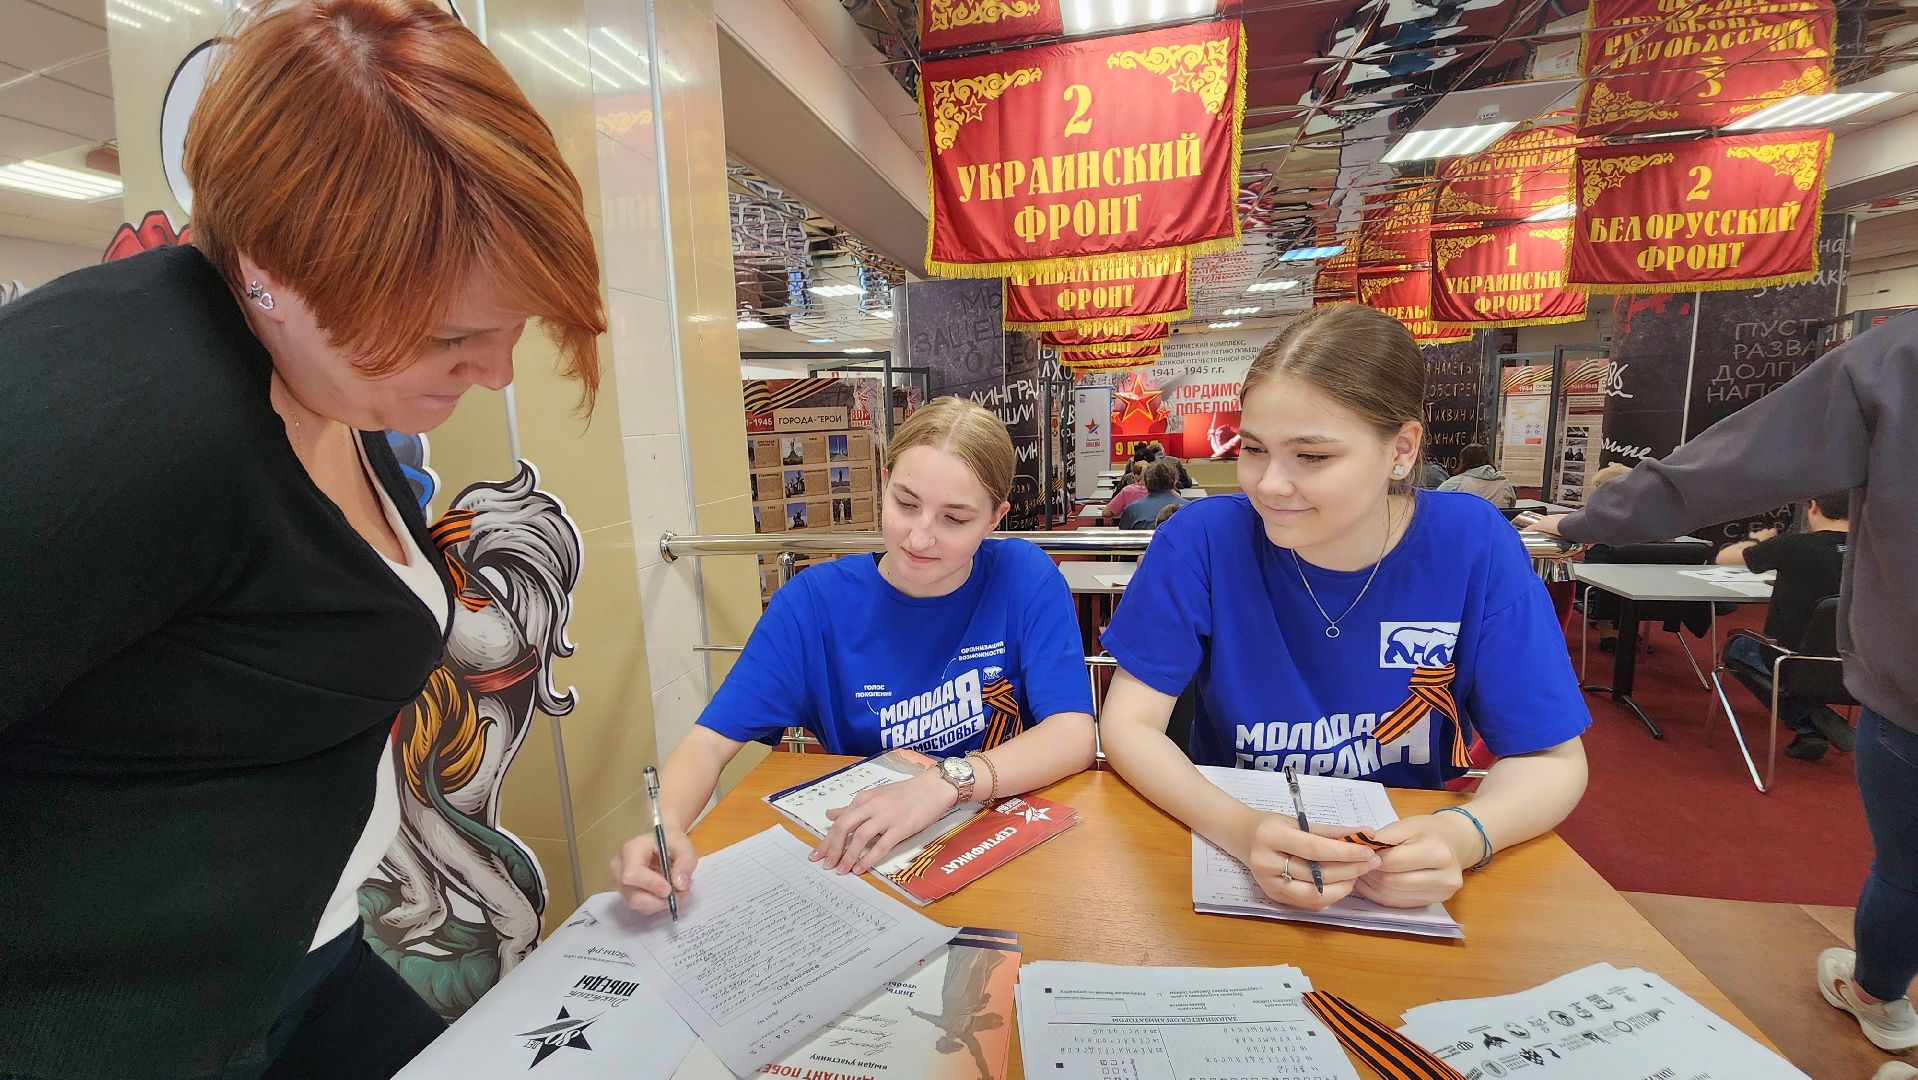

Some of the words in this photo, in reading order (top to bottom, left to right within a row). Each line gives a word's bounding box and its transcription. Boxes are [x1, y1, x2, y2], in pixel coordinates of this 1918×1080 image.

[1063, 84, 1093, 138] 2
[956, 132, 1202, 203] УКРАИНСКИЙ
[1686, 165, 1713, 202] 2
[1013, 194, 1142, 243] ФРОНТ
[1590, 201, 1799, 243] БЕЛОРУССКИЙ
[1505, 243, 1518, 266] 1
[1636, 242, 1745, 272] ФРОНТ
[1446, 270, 1561, 295] УКРАИНСКИ
[1057, 285, 1134, 311] ФРОНТ
[1474, 293, 1544, 314] ФРОНТ
[1152, 368, 1174, 376] 1941
[1185, 366, 1208, 375] 1945
[1175, 383, 1242, 399] ГОРДИМС
[778, 415, 843, 425] ГОРОДА-ГЕРОИ
[1115, 441, 1123, 455] 9
[961, 641, 1004, 654] ОРГАНИЗАЦИЯ
[939, 826, 1018, 875] СЕРТИФИКАТ
[574, 975, 640, 998] ПОБЕДЫ
[1111, 1016, 1179, 1024] ОРГАНИЗАТОРОМ
[809, 1053, 856, 1068] участнику
